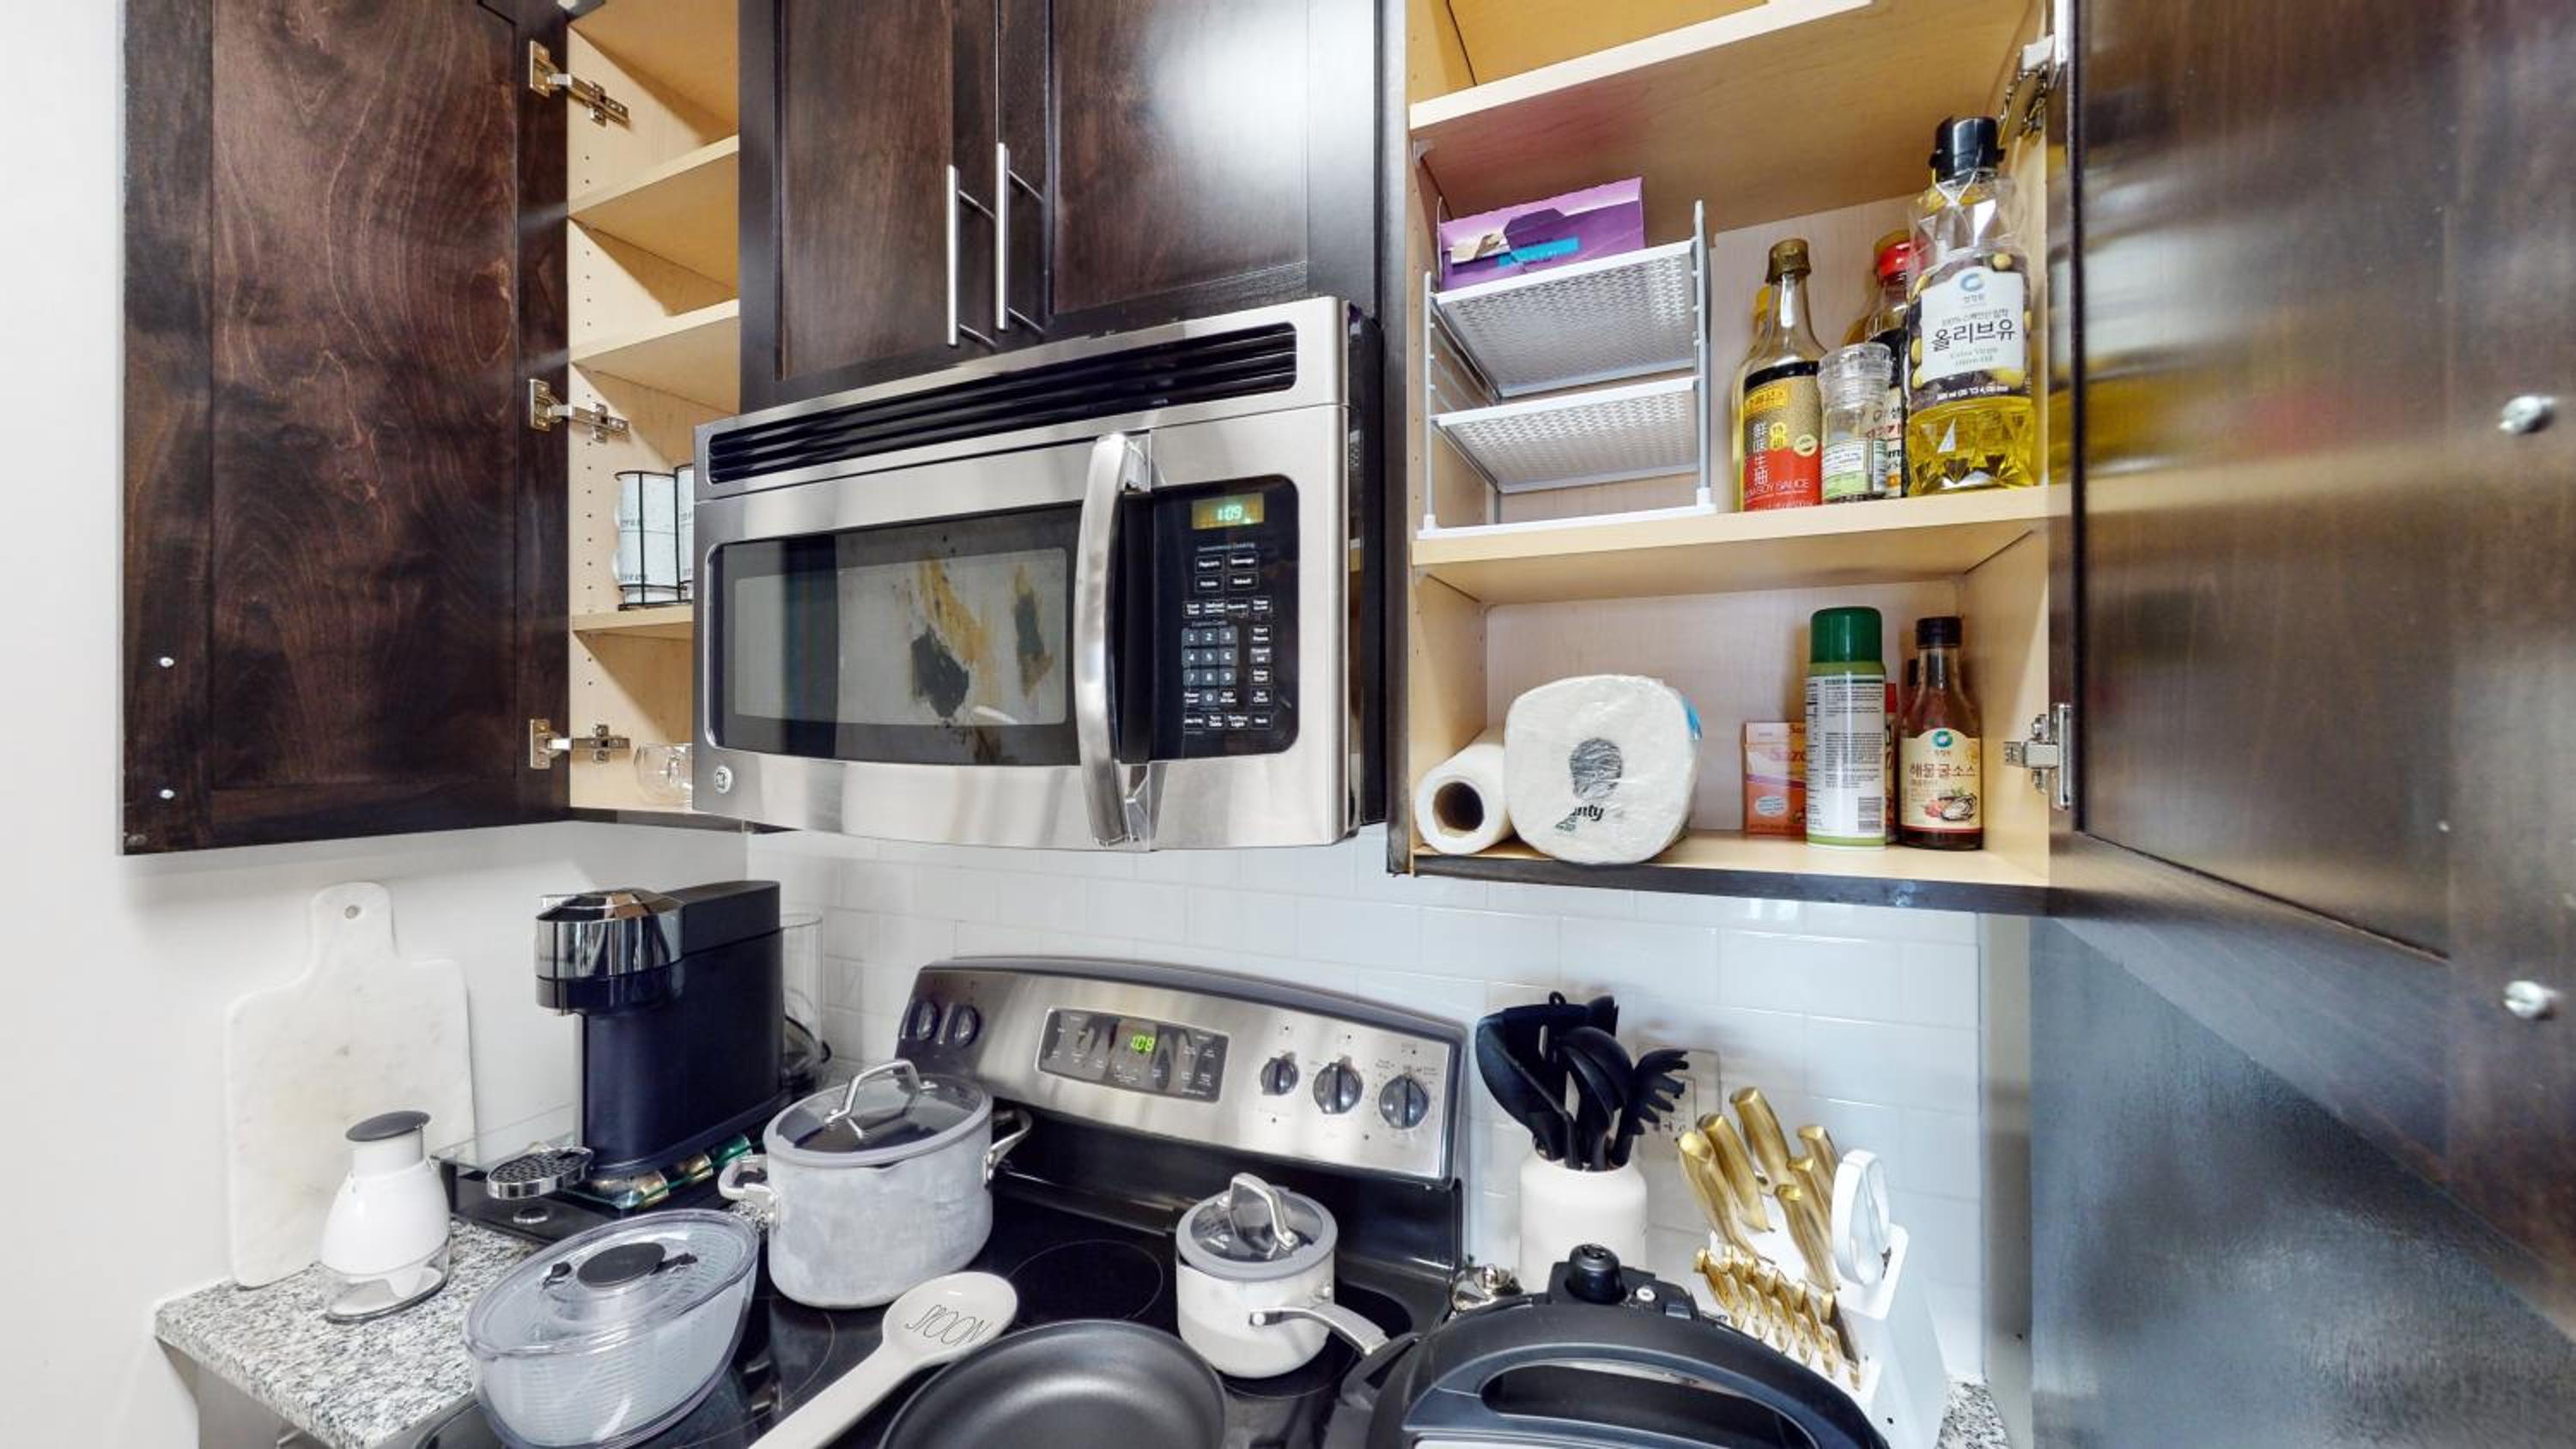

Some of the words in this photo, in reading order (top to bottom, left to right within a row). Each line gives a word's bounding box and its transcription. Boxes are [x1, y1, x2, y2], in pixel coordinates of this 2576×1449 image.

[1931, 318, 2015, 353] 올리브유
[1775, 478, 1810, 493] SAUCE
[1206, 632, 1212, 641] 2
[1188, 652, 1195, 661] 4
[905, 1303, 993, 1347] SPOON
